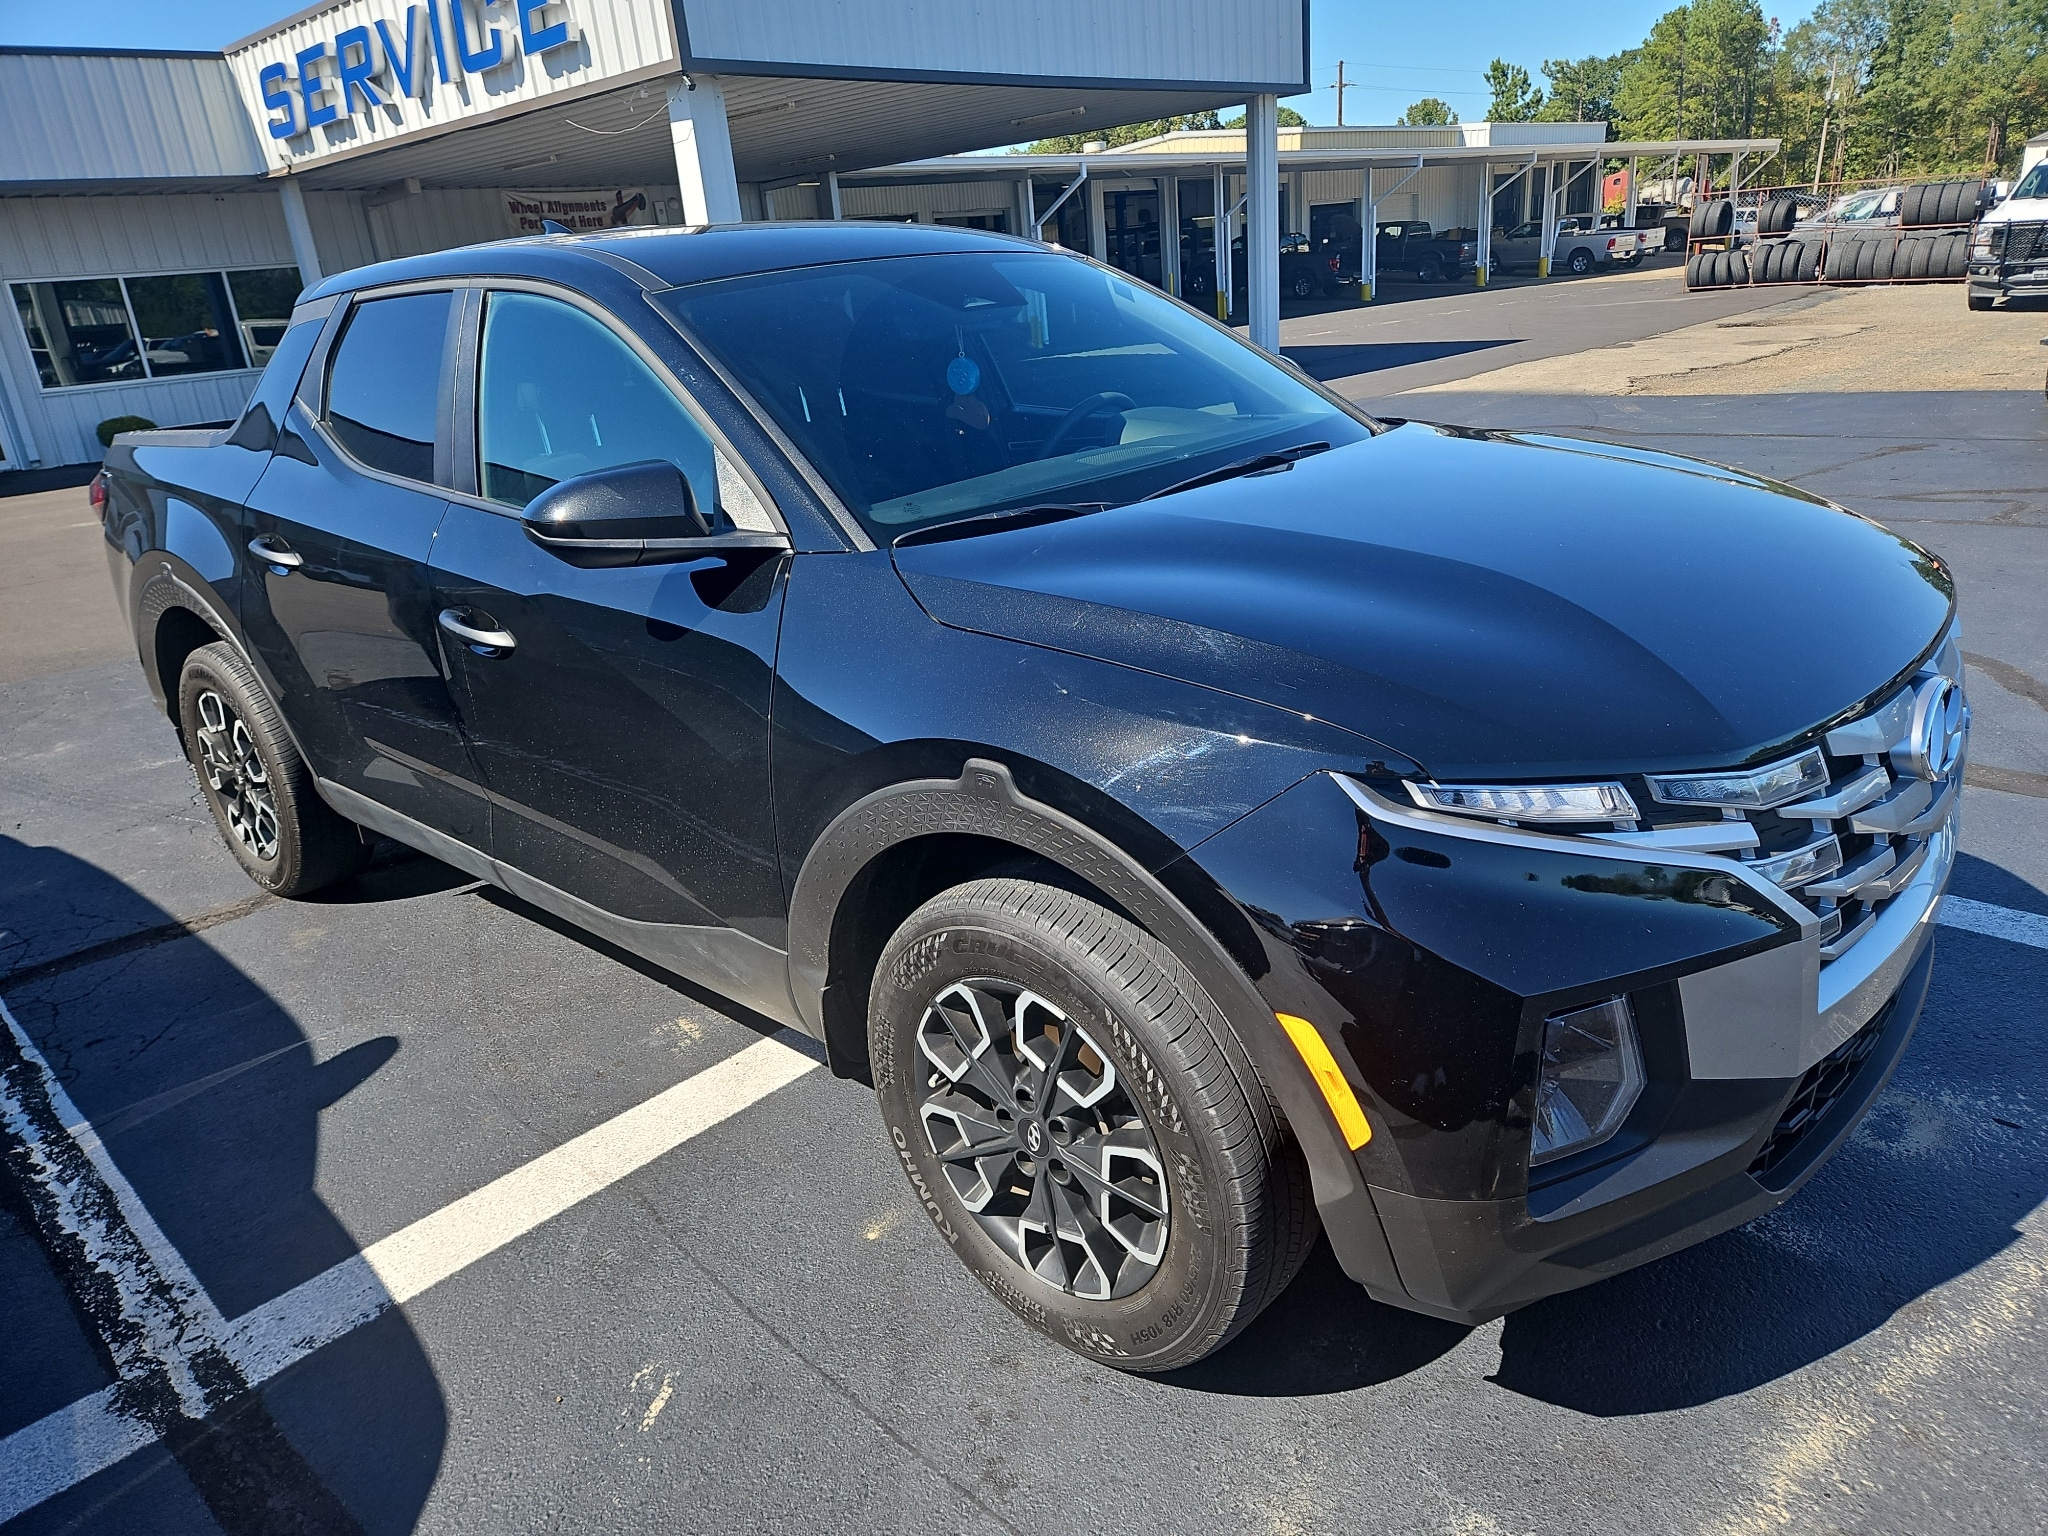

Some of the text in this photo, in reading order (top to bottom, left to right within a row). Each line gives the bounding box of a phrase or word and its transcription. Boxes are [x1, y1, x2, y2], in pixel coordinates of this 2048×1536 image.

[260, 0, 572, 140] SERVICE
[509, 200, 607, 215] Wheel Alignments
[579, 215, 603, 227] Here
[892, 1126, 959, 1245] KUMHO
